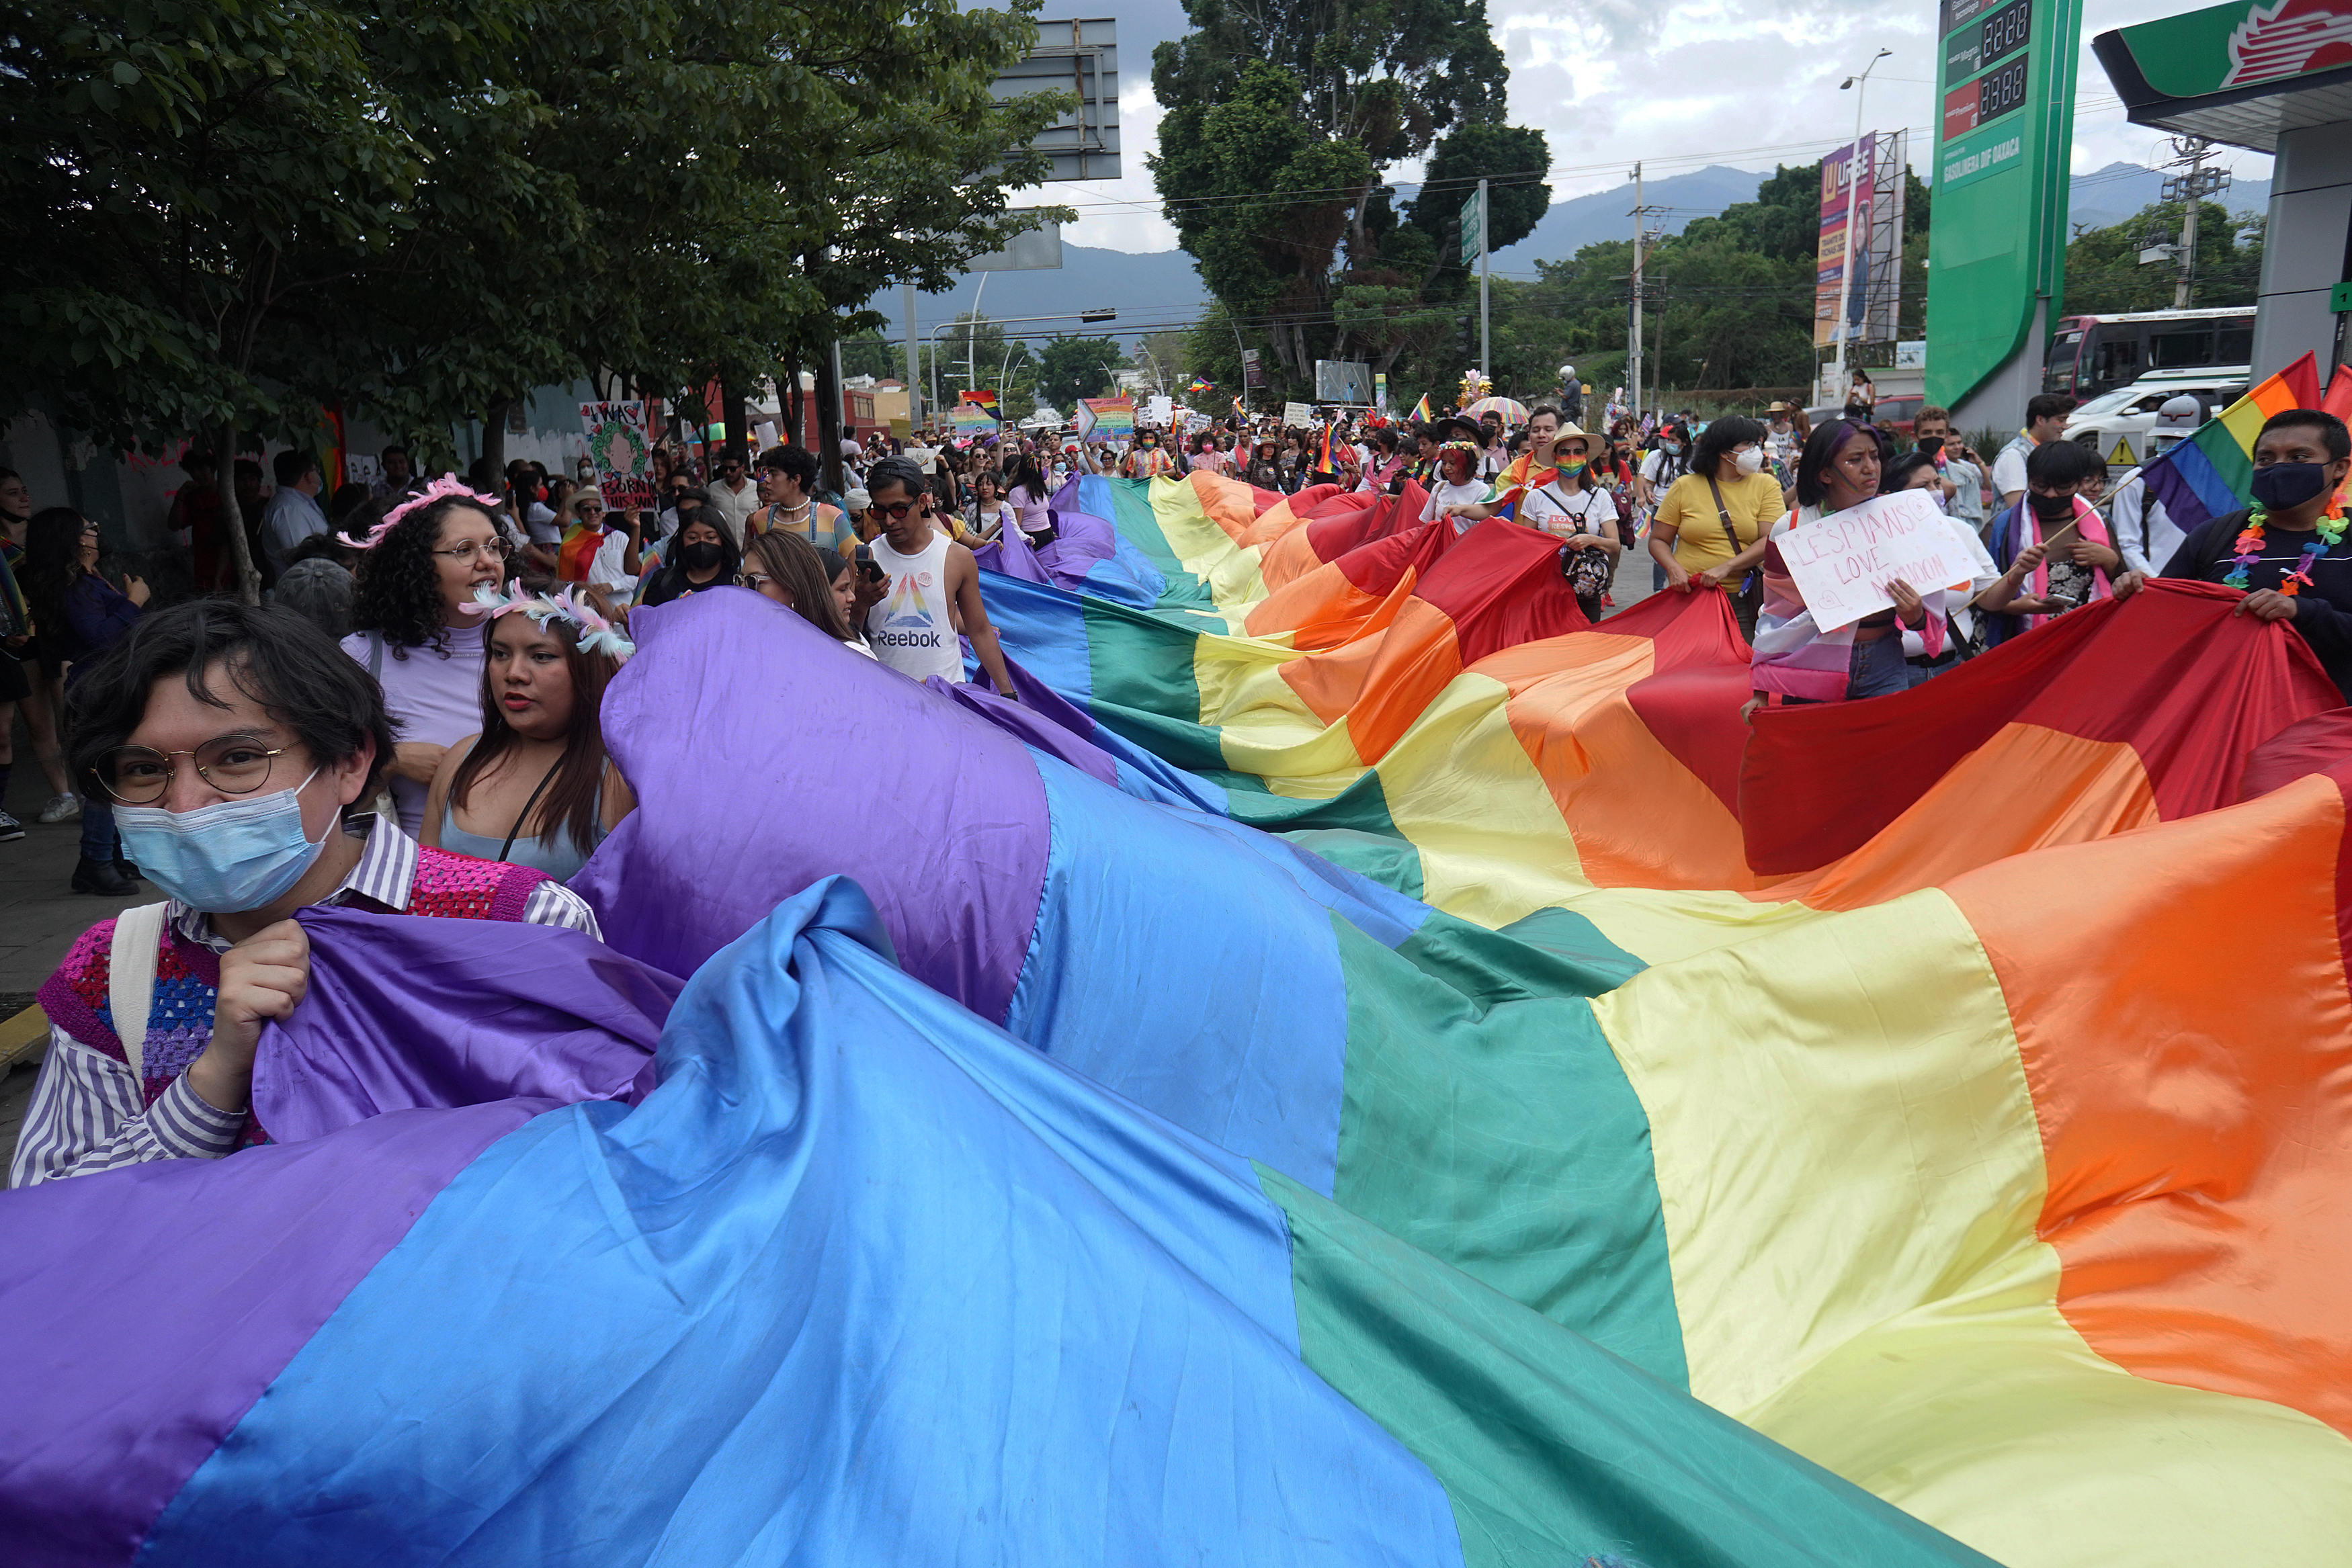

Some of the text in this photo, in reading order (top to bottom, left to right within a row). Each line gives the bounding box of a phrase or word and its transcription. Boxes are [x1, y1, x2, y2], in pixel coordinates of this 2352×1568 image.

[1943, 136, 2020, 183] GASOLINERA DIF OAXACA
[2339, 292, 2347, 302] 1
[600, 404, 638, 425] WAS
[601, 479, 646, 495] BORN
[603, 495, 658, 511] THIS WAY
[1790, 504, 1916, 566] LESBIANS
[1834, 546, 1890, 585] LOVE
[878, 629, 941, 648] Reebok
